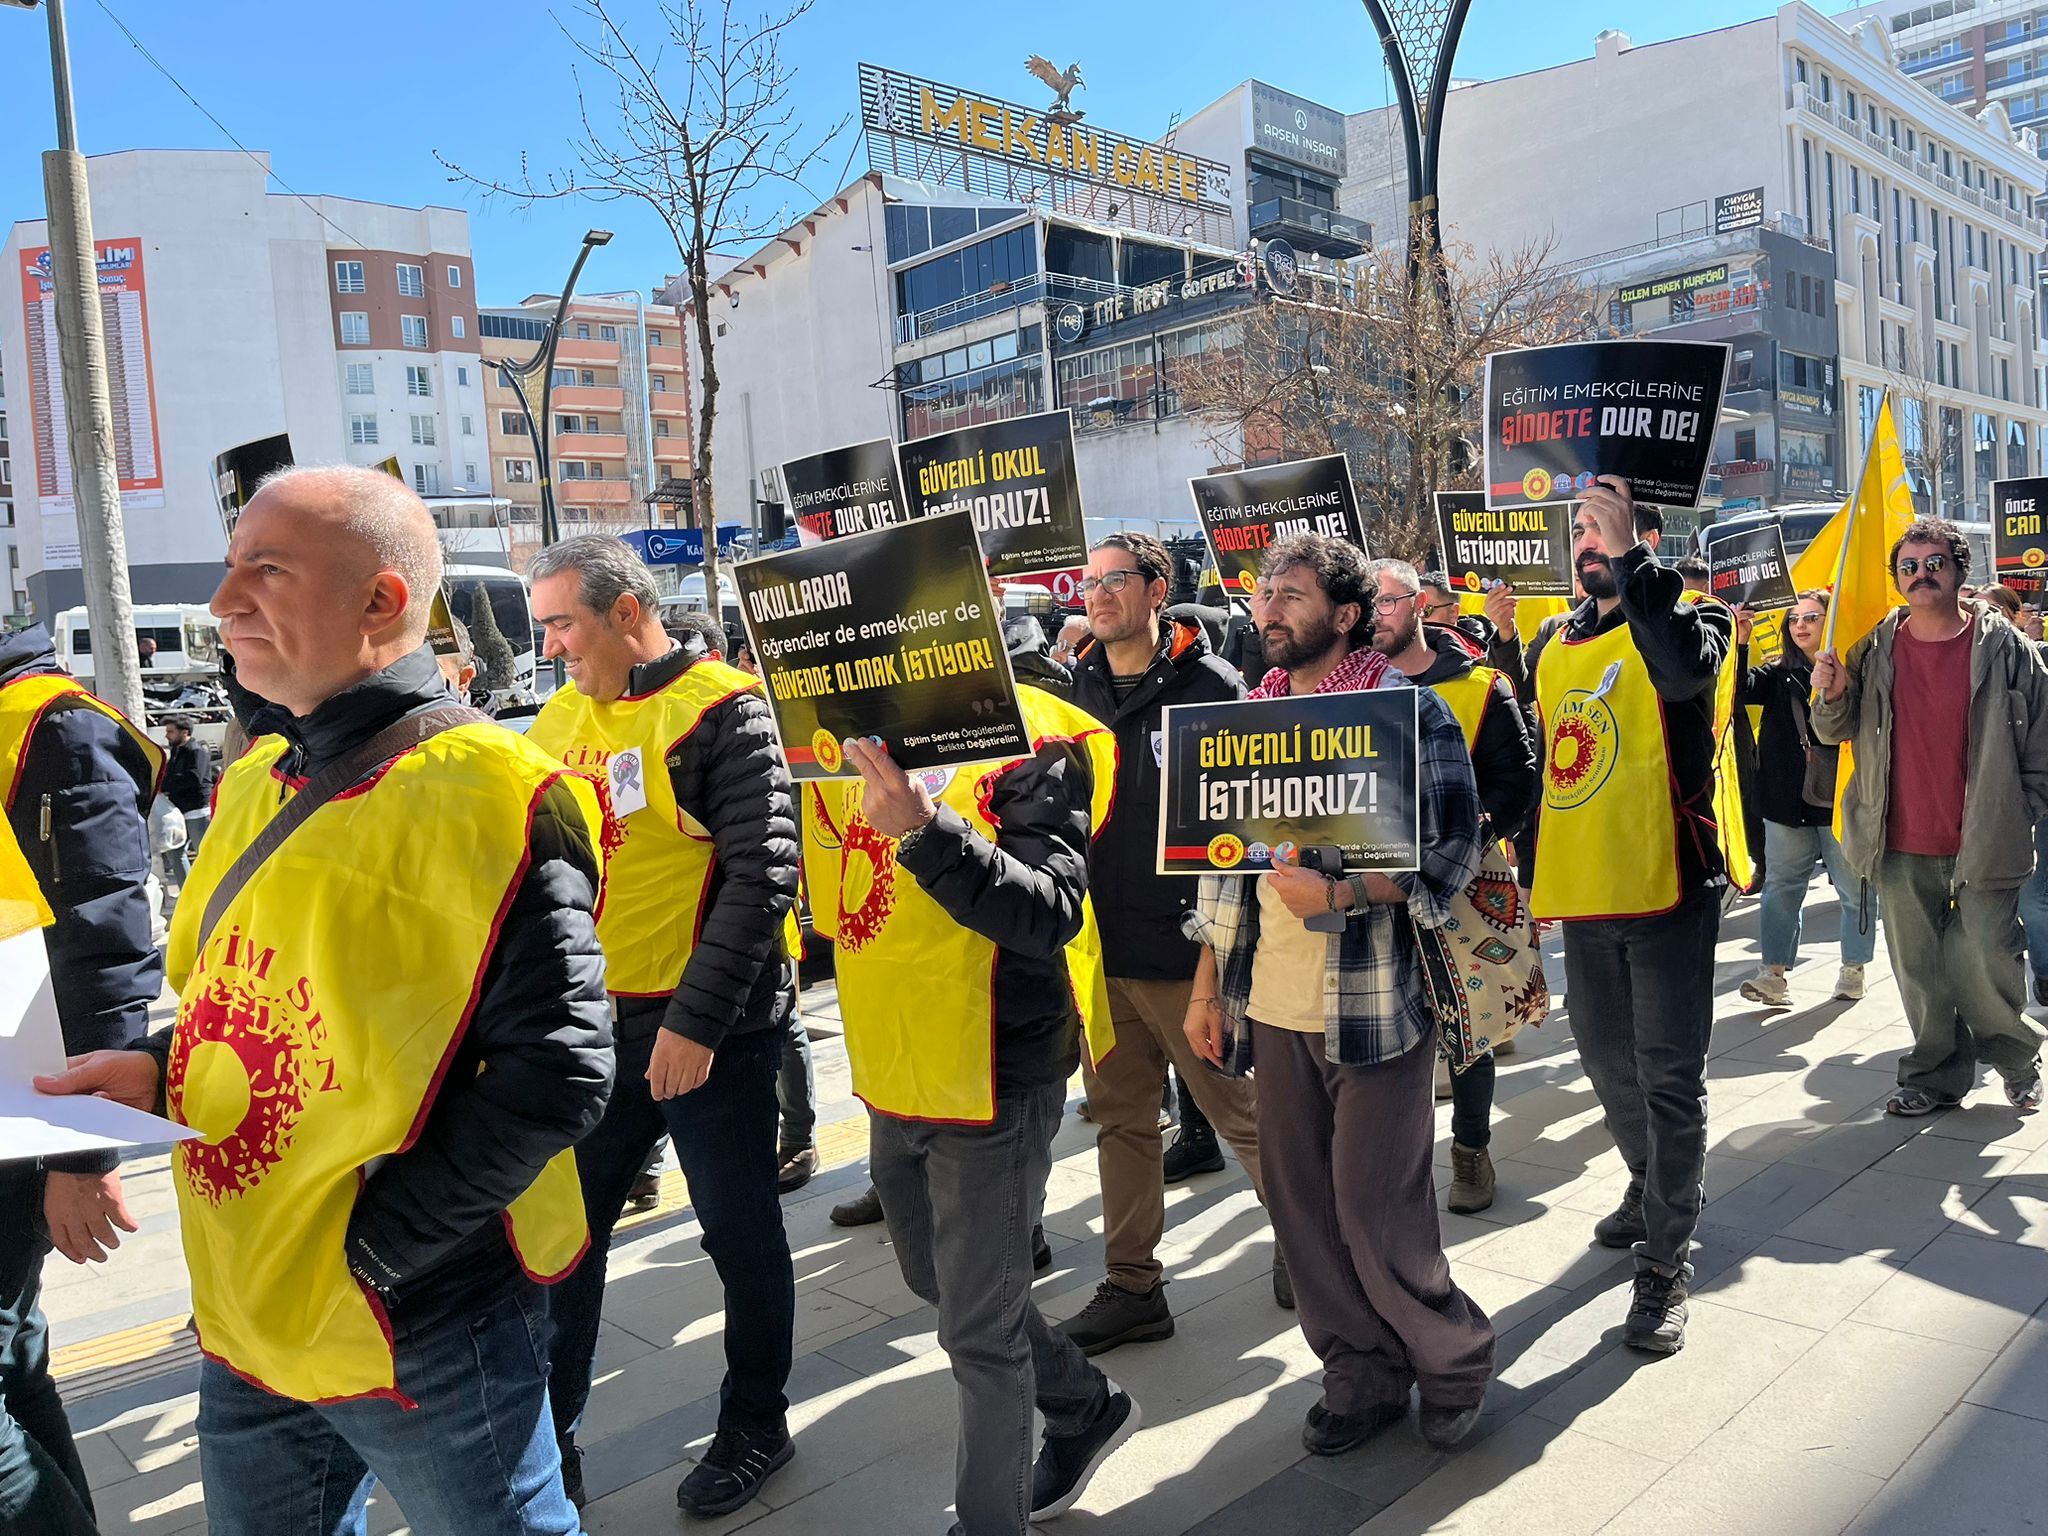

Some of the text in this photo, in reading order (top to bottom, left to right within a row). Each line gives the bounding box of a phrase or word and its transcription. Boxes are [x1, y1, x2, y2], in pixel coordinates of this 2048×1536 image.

[919, 86, 1198, 201] MEKAN CAFE
[1264, 123, 1299, 146] ARSEN
[1717, 199, 1762, 217] ALTINBAŞ
[1723, 192, 1755, 207] DUYGU
[96, 246, 134, 264] LİM
[1093, 268, 1236, 326] THE REST COFFEE
[1621, 288, 1649, 303] ÖZLEM
[1652, 279, 1681, 295] ERKEK
[1502, 379, 1704, 408] EĞİTİM EMEKÇİLERİNE
[1502, 406, 1700, 452] ŞİDDETE DUR DE!
[919, 446, 1046, 496] GÜVENLİ OKUL
[793, 477, 890, 509] EĞİTİM EMEKÇİLERİNE
[1206, 491, 1342, 522] EĞİTİM EMEKÇİLERİNE
[2005, 498, 2035, 514] ÖNCE
[834, 505, 868, 535] DUR
[868, 499, 898, 529] DE!
[922, 487, 1052, 533] ORUZ!
[1452, 508, 1548, 532] GÜVENLİ OKUL
[2006, 515, 2041, 536] CAN
[1212, 523, 1273, 556] ŞİDDETE
[1315, 511, 1348, 539] DE!
[1454, 534, 1550, 565] İSTİYORUZ!
[1739, 565, 1760, 584] DUR
[1761, 561, 1781, 580] DE!
[748, 570, 852, 624] OKULLARDA
[761, 600, 981, 660] öğrenciler de emekçiler de
[770, 637, 995, 702] GÜVENDE OLMAK İSTİYOR!
[903, 721, 1016, 748] Eğitim Sen'de Örgütlenelim
[937, 734, 1020, 754] Birlikte Değiştirelim
[1200, 723, 1379, 768] GÜVENLİ OKUL
[1199, 770, 1378, 822] İSTİYORUZ!
[1361, 842, 1410, 852] Örgütlenelim
[1363, 850, 1410, 861] Değiştirelim
[285, 976, 343, 1093] SEN
[358, 1238, 402, 1279] OMNI-HEAT
